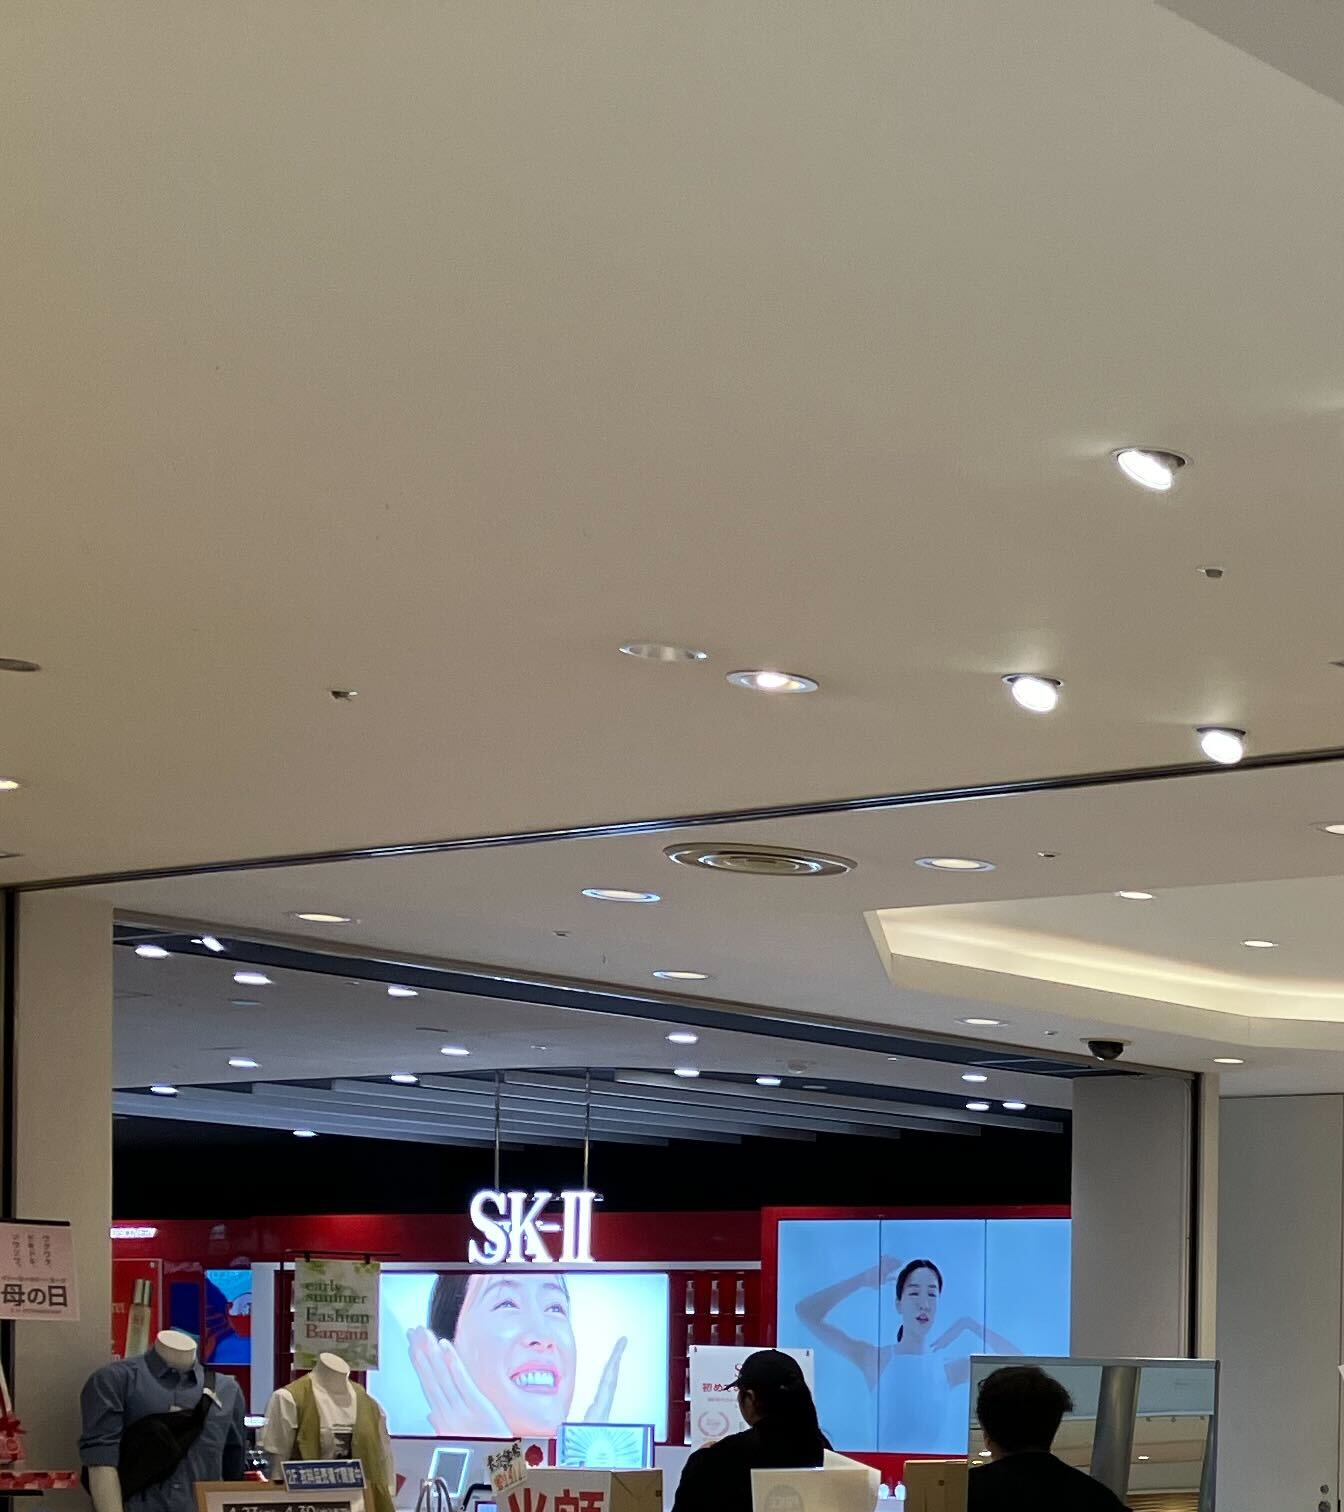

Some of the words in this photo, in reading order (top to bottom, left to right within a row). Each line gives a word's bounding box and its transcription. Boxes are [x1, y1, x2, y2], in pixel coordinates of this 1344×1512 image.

[469, 1190, 596, 1265] SK-II
[1, 1283, 68, 1307] 母の日
[305, 1280, 341, 1295] early
[305, 1293, 367, 1306] summer
[305, 1307, 369, 1324] Fashion
[305, 1324, 369, 1342] Bargain
